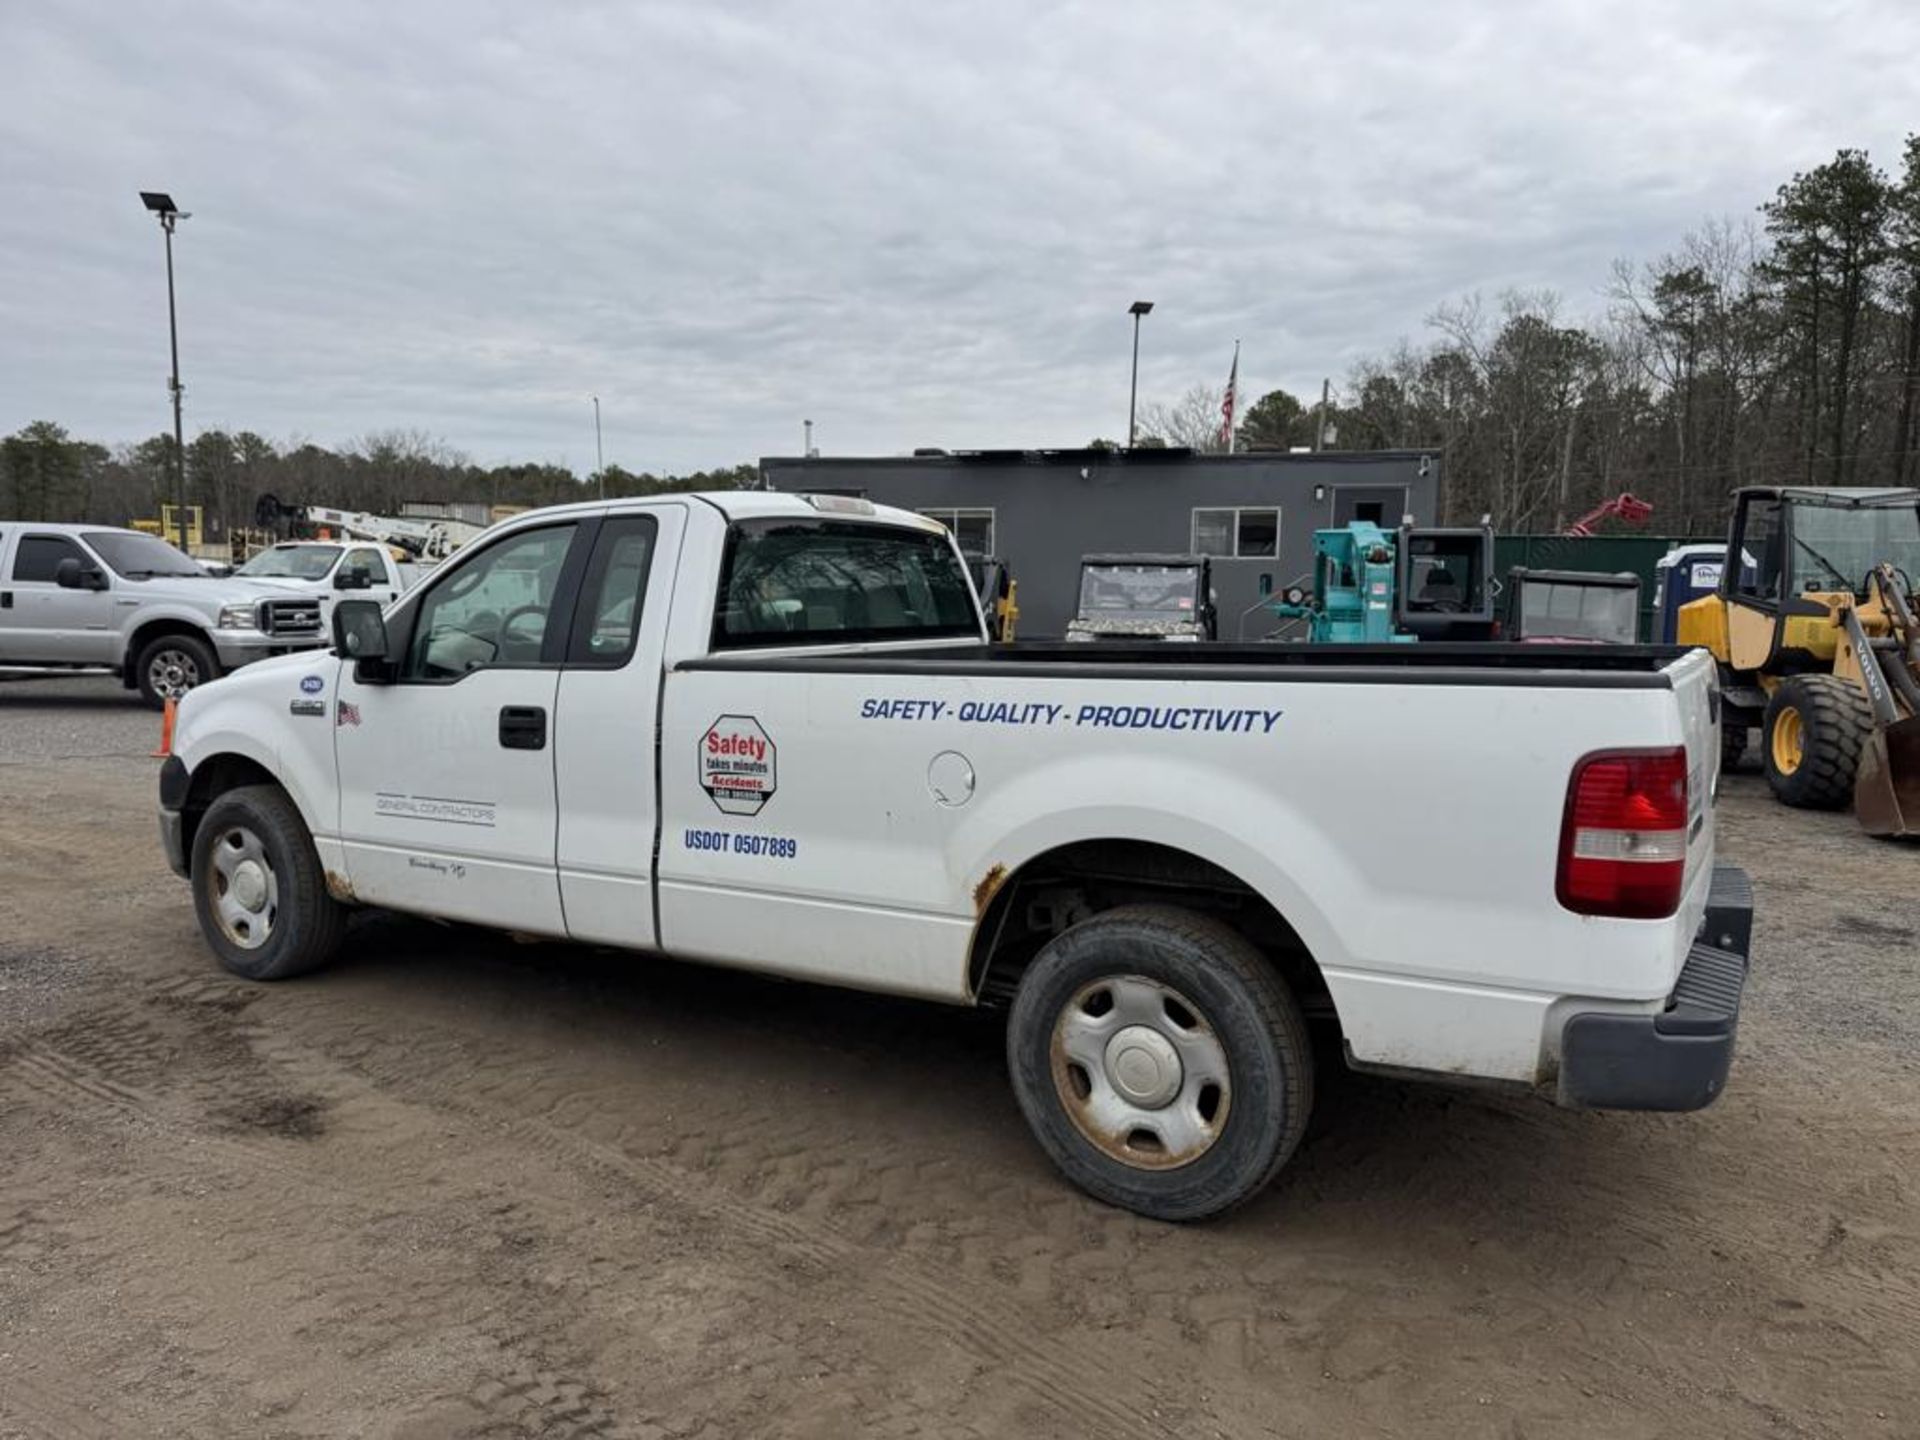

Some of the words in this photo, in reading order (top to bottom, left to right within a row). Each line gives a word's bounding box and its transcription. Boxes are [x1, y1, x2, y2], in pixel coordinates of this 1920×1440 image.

[1857, 640, 1881, 700] VOLVO
[861, 699, 946, 721] SAFETY
[958, 702, 1062, 725] QUALITY
[1076, 706, 1283, 733] PRODUCTIVITY
[708, 731, 767, 761] Safety
[706, 757, 731, 771] takes
[733, 760, 768, 773] minutes
[712, 775, 764, 789] Accidents
[419, 803, 496, 821] CONTRACTORS
[685, 829, 730, 851] USDOT
[734, 834, 797, 858] 0507889
